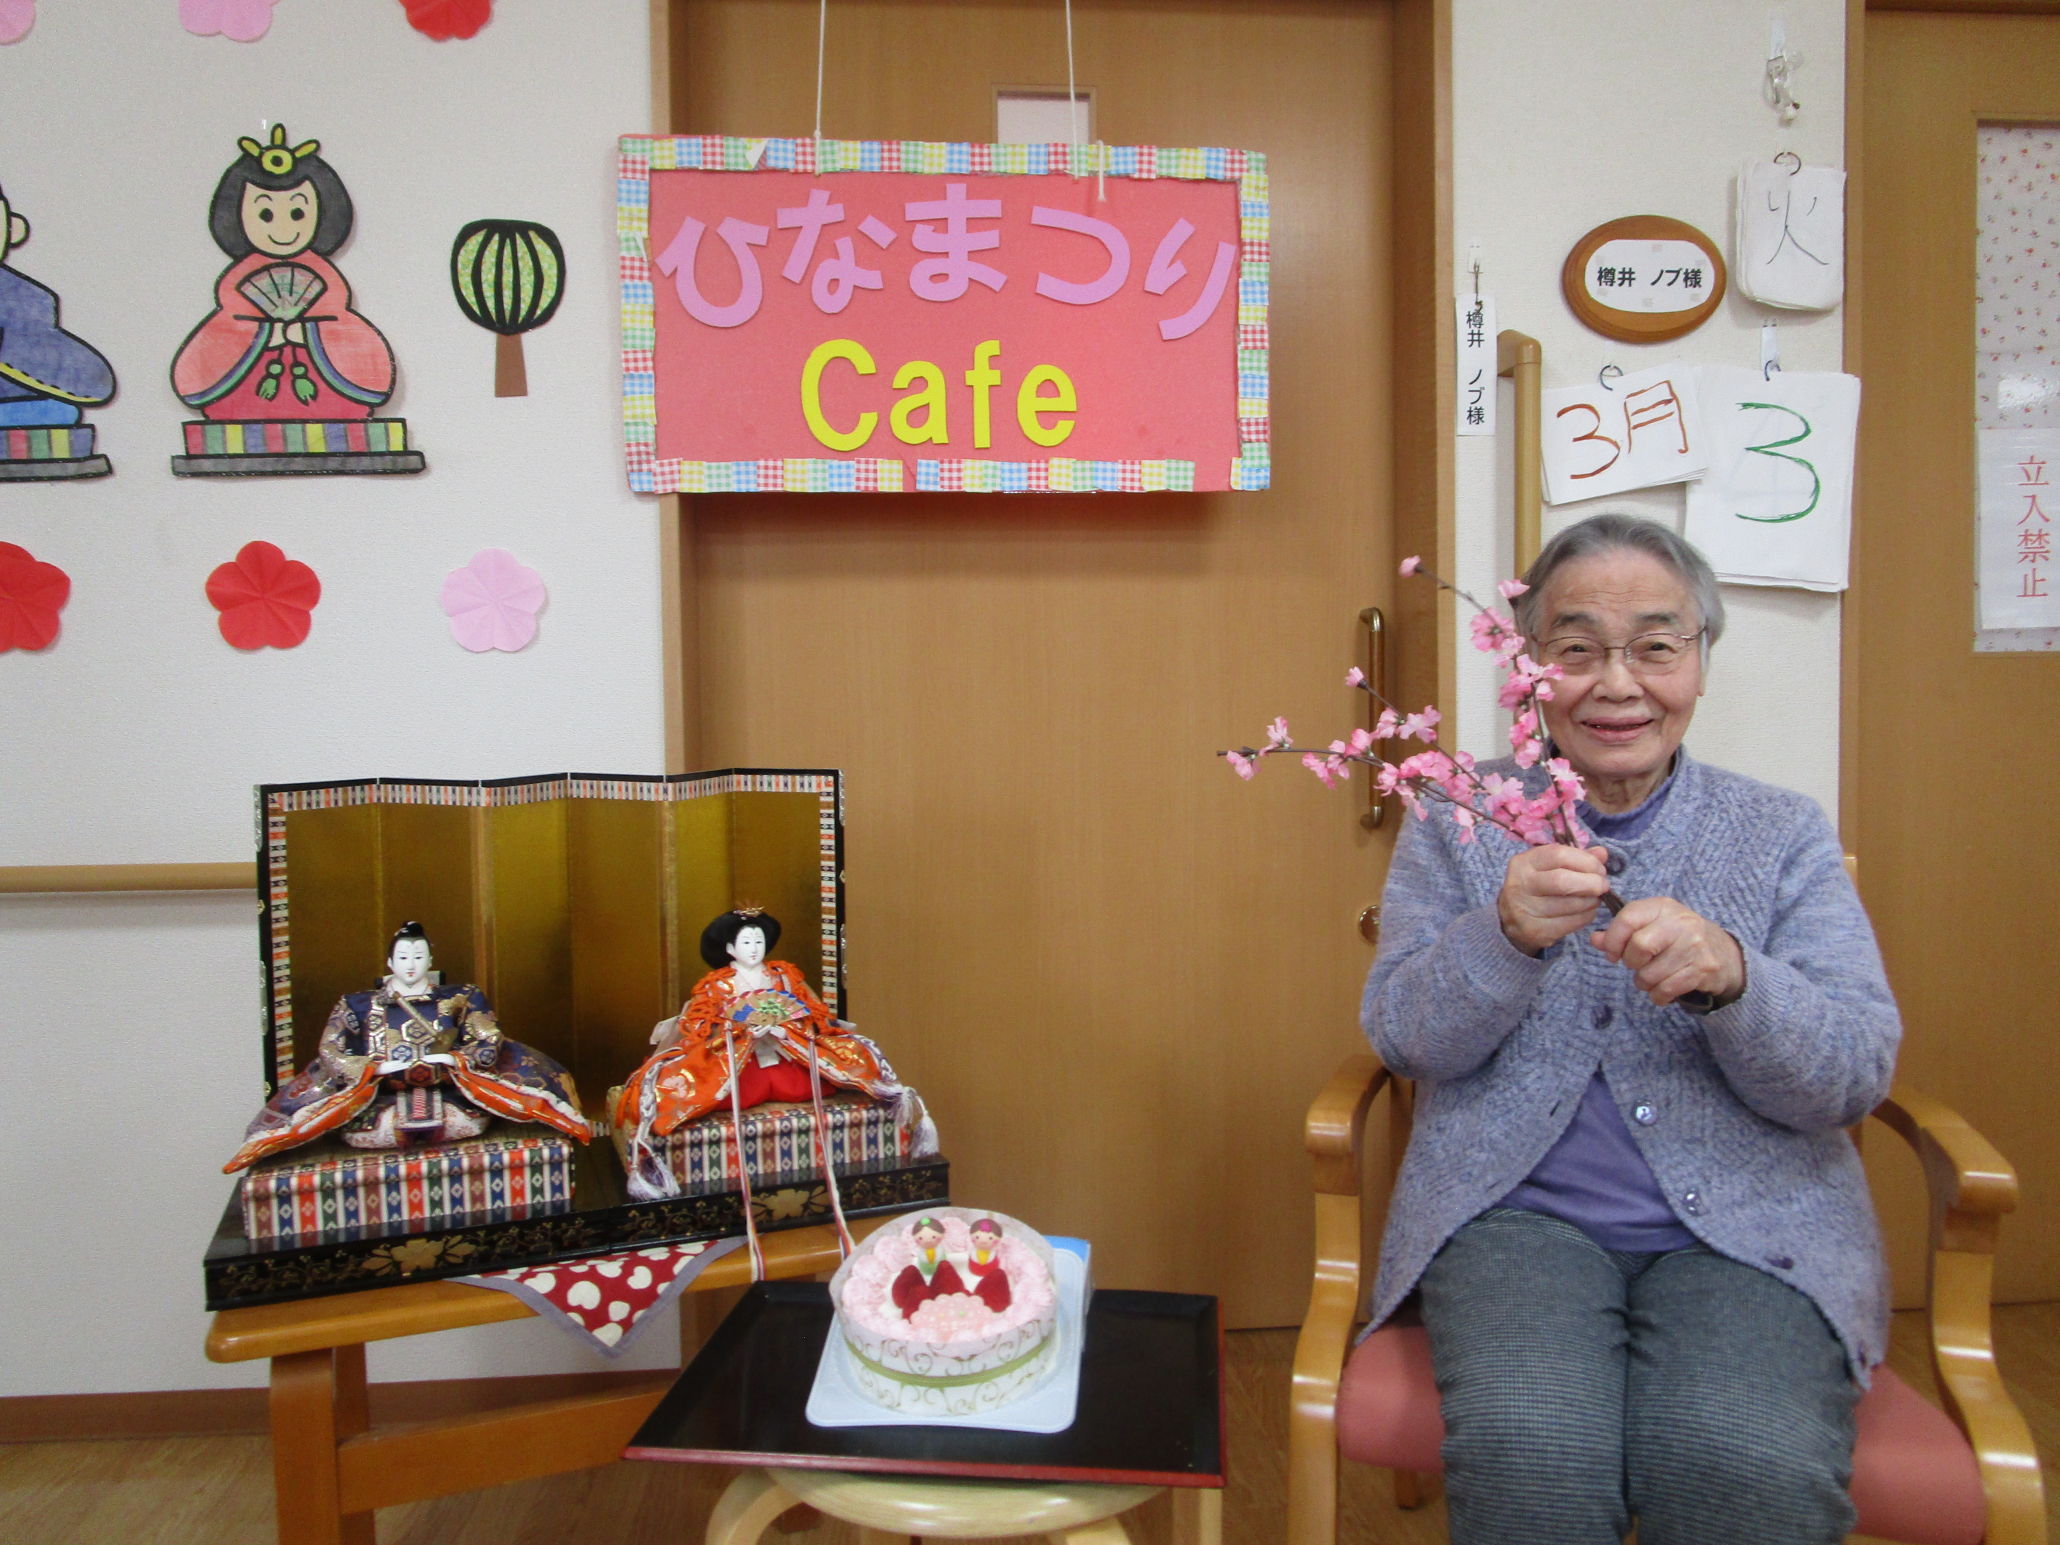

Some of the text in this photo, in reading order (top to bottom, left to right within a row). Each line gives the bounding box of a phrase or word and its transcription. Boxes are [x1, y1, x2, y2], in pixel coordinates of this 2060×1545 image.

[656, 183, 1236, 341] ひなまつり
[1597, 266, 1703, 289] 樽井 ノブ様
[1766, 190, 1830, 266] 火
[800, 338, 1078, 451] Cafe
[1466, 368, 1486, 426] ノブ様
[1556, 380, 1689, 480] 3月
[1735, 401, 1822, 524] 3
[2016, 454, 2051, 598] 立入禁止
